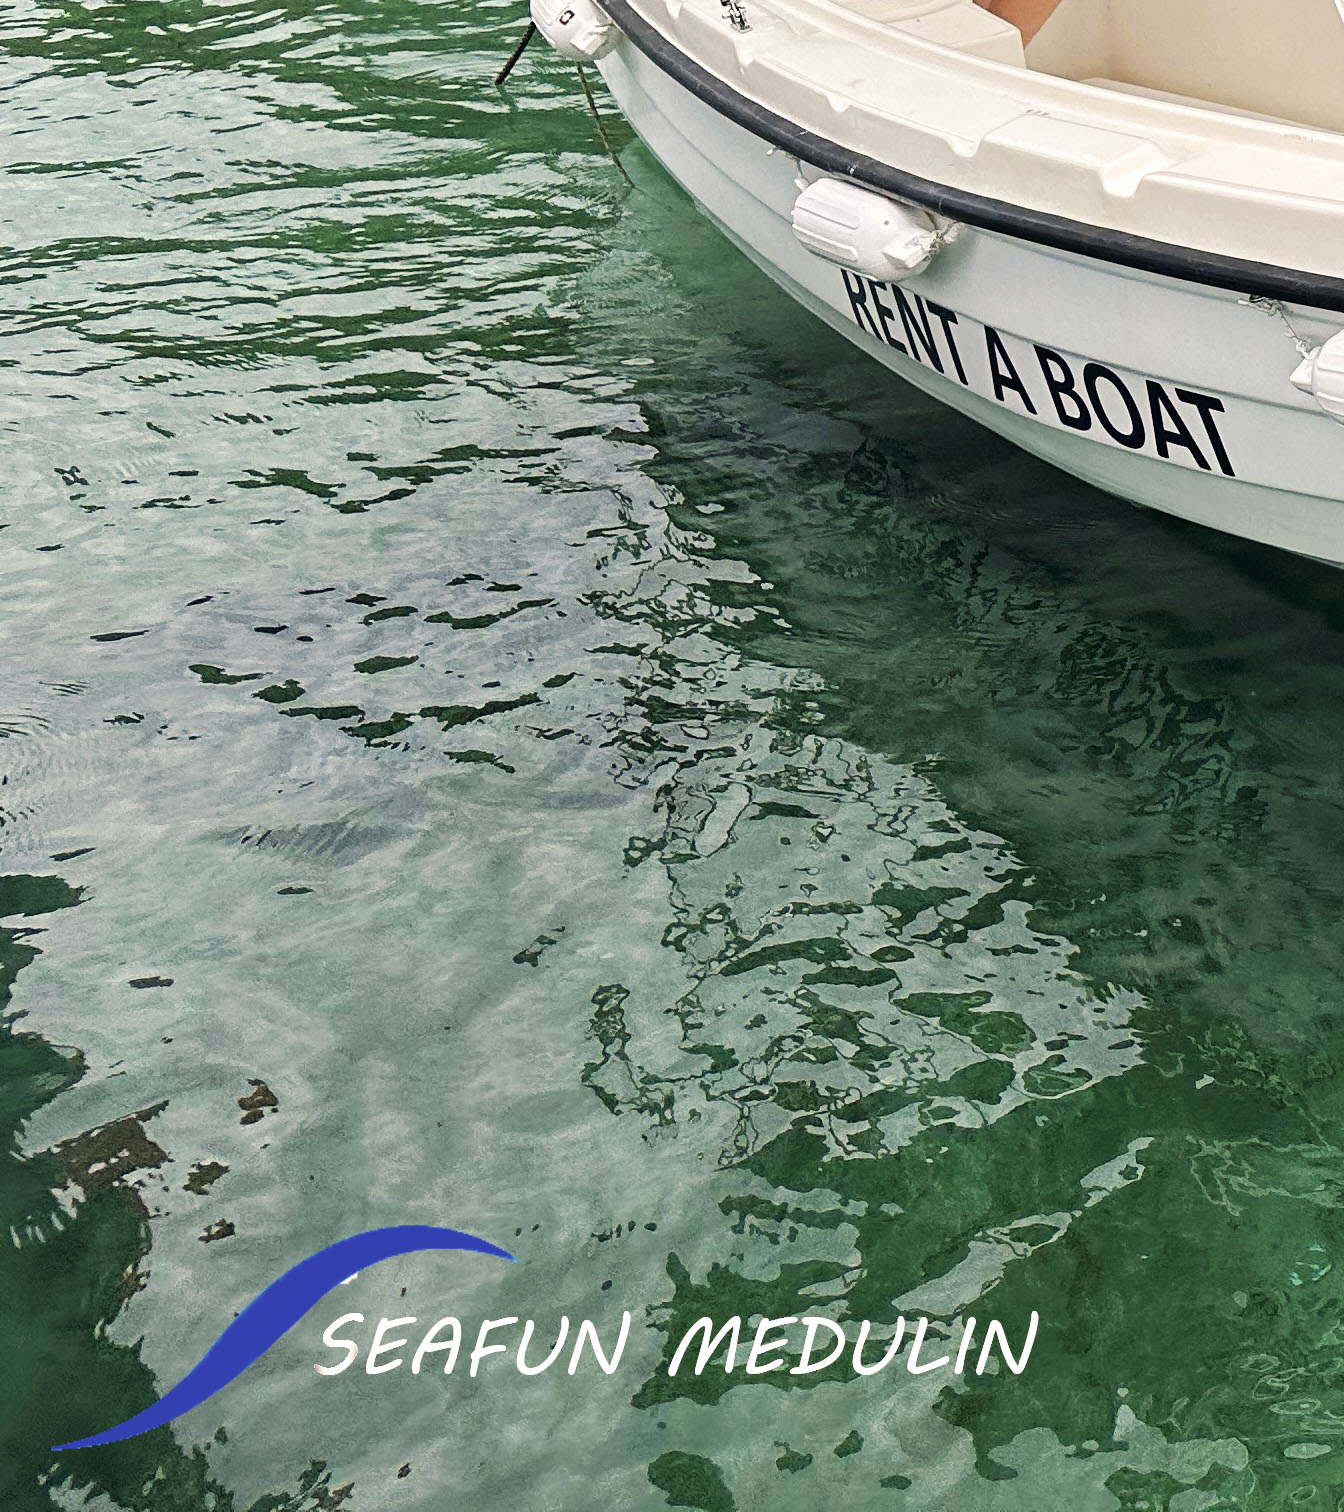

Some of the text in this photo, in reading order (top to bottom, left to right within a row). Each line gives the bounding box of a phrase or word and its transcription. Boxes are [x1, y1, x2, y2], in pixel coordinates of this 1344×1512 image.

[839, 267, 1237, 478] RENT A BOAT
